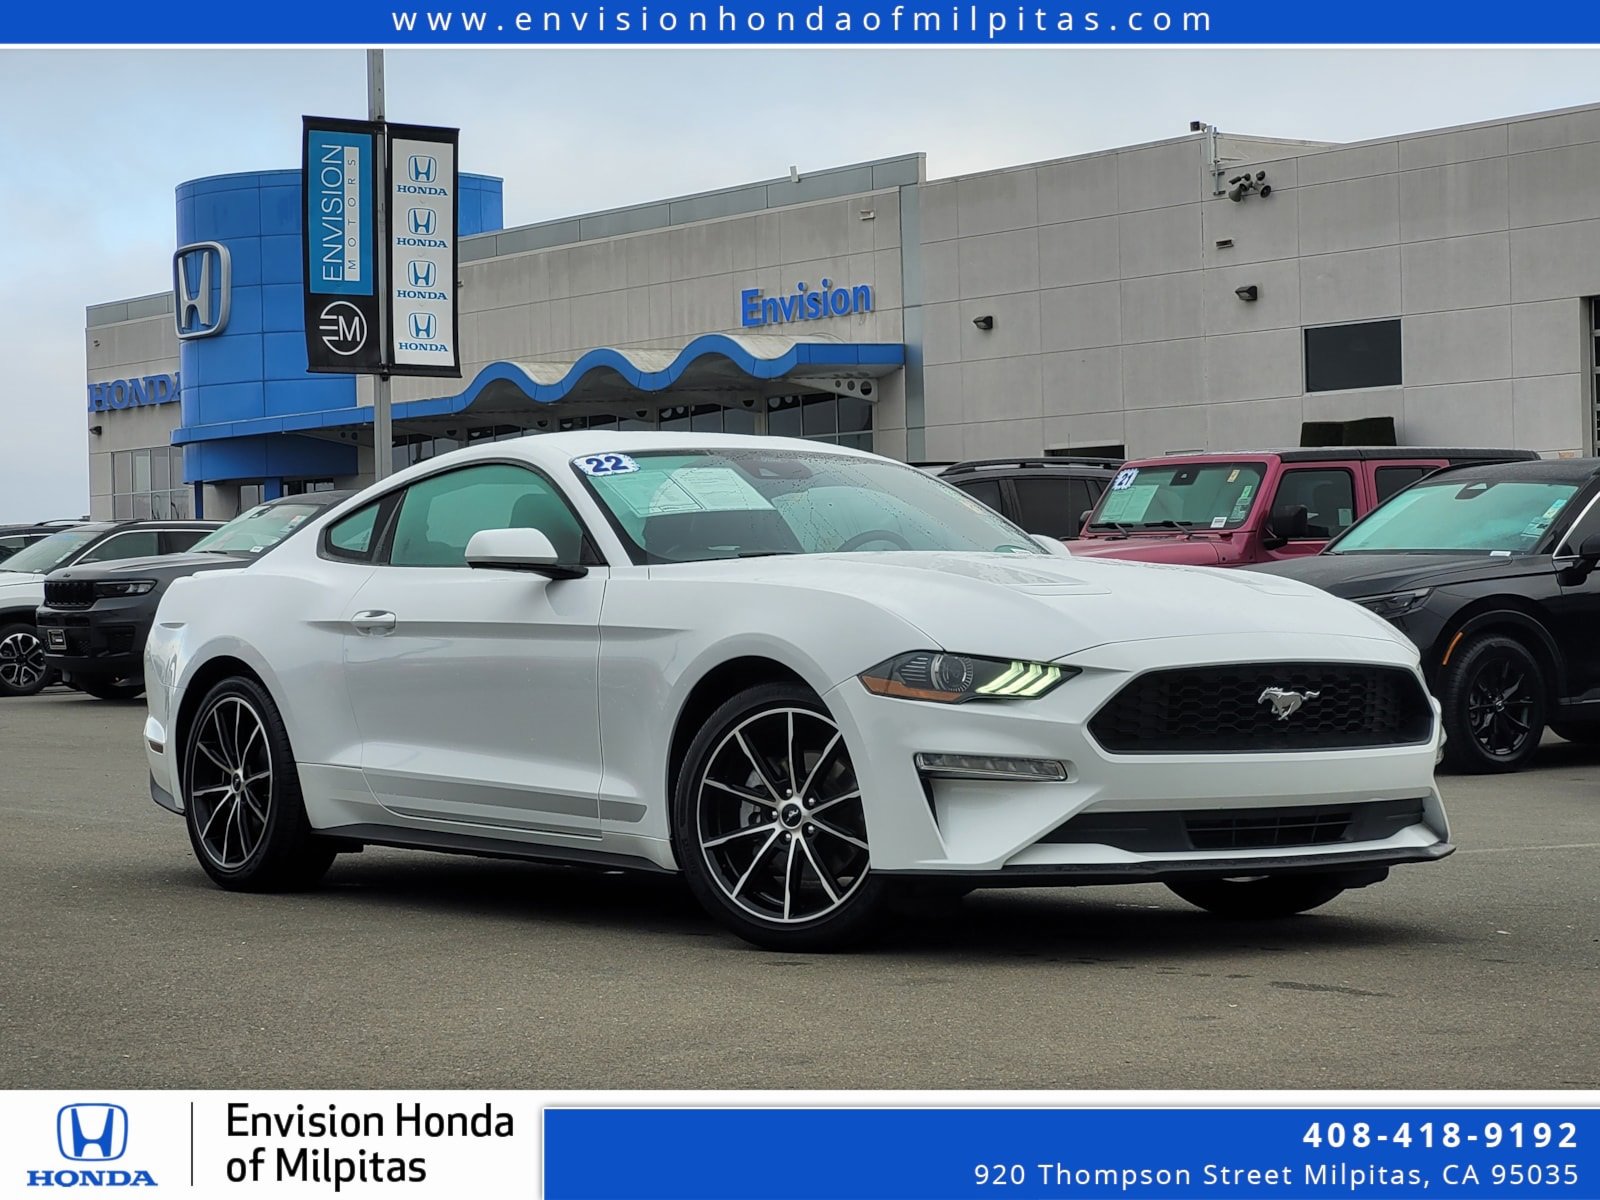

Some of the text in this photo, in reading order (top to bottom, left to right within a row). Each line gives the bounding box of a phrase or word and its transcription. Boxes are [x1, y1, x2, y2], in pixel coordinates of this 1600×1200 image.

[397, 184, 448, 196] HONDA
[321, 144, 343, 281] ENVISION
[347, 159, 357, 270] MOTORS
[396, 237, 448, 248] HONDA
[397, 289, 448, 300] HONDA
[741, 277, 875, 328] Envision
[398, 342, 448, 352] HONDA
[585, 455, 630, 473] 22
